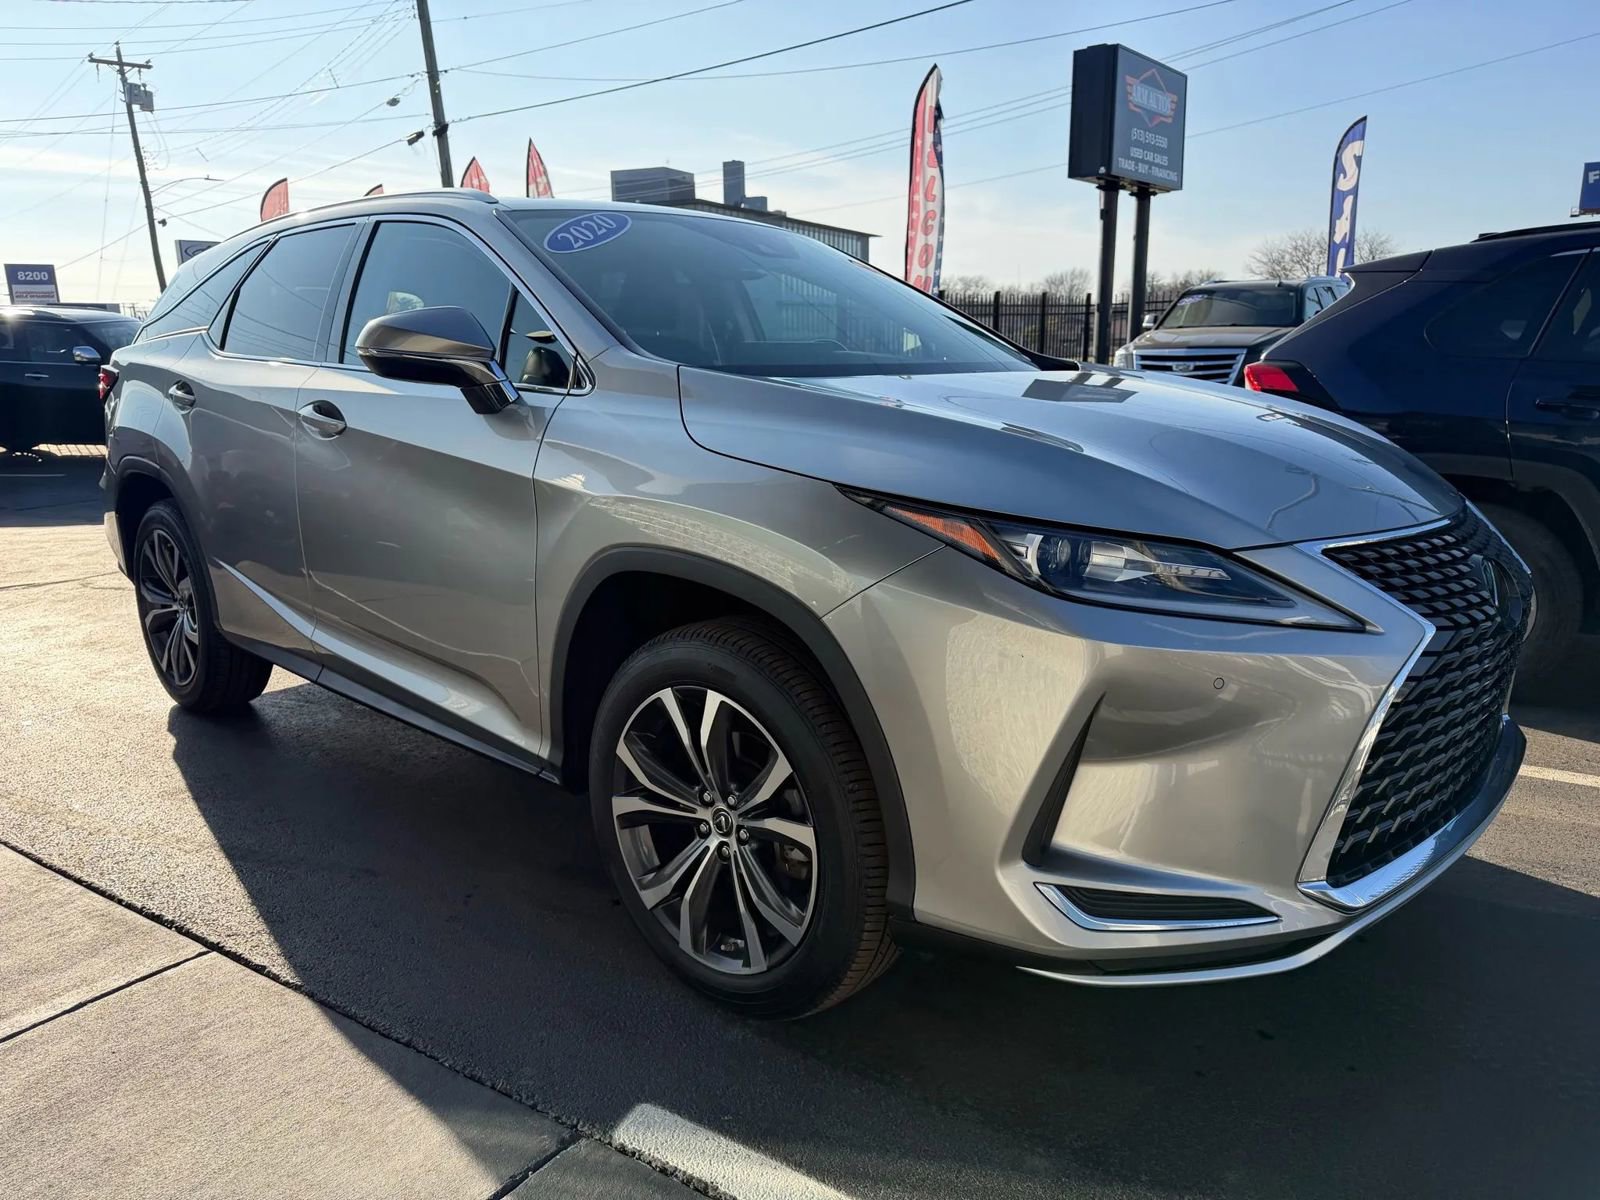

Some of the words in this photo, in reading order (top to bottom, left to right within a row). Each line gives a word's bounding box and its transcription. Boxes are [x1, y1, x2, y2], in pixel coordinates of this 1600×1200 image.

[1130, 147, 1143, 159] USED
[1143, 150, 1153, 162] CAR
[1154, 153, 1168, 166] SALES
[1118, 157, 1135, 171] TRADE
[1138, 162, 1149, 174] BUY
[1151, 166, 1178, 182] FINANCING
[557, 214, 617, 249] 2020
[17, 271, 49, 281] 8200
